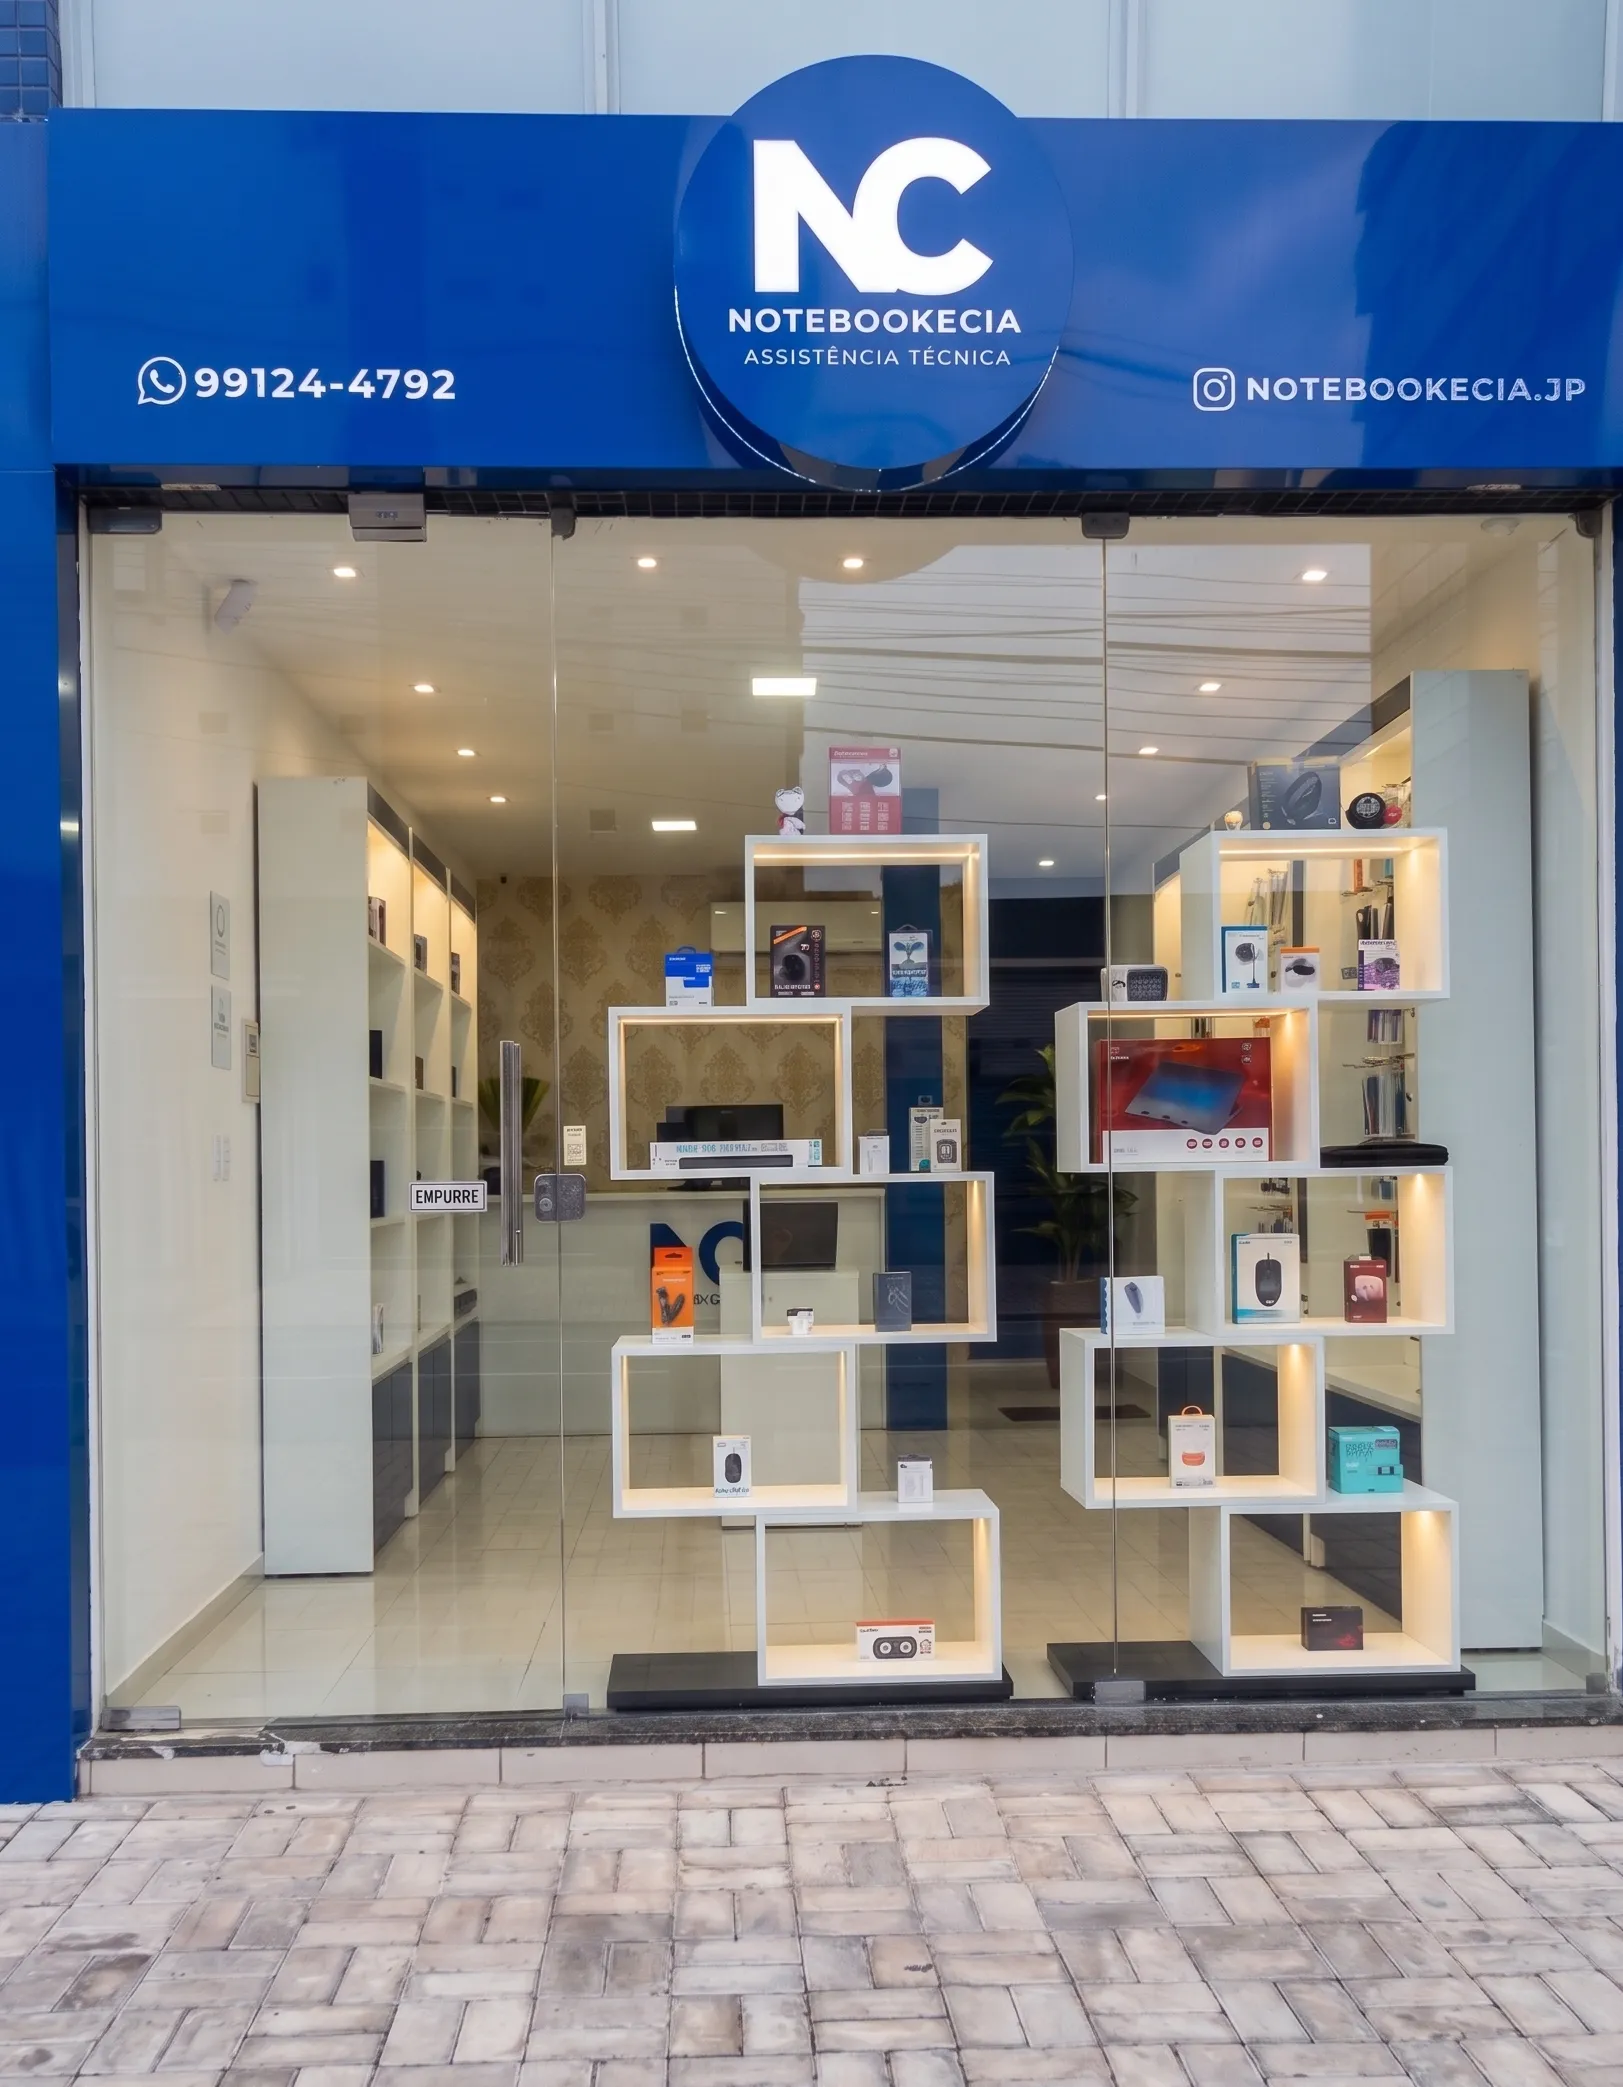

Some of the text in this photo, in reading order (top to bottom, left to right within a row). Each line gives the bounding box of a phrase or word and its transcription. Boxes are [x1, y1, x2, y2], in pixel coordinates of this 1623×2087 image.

[753, 136, 995, 296] NC
[728, 307, 1022, 334] NOTEBOOKECIA
[743, 345, 1012, 367] ASSISTÊNCIA TÉCNICA
[194, 367, 456, 400] 99124-4792
[1246, 376, 1587, 402] NOTEBOOKECIA.JP
[415, 1189, 479, 1204] EMPURRE
